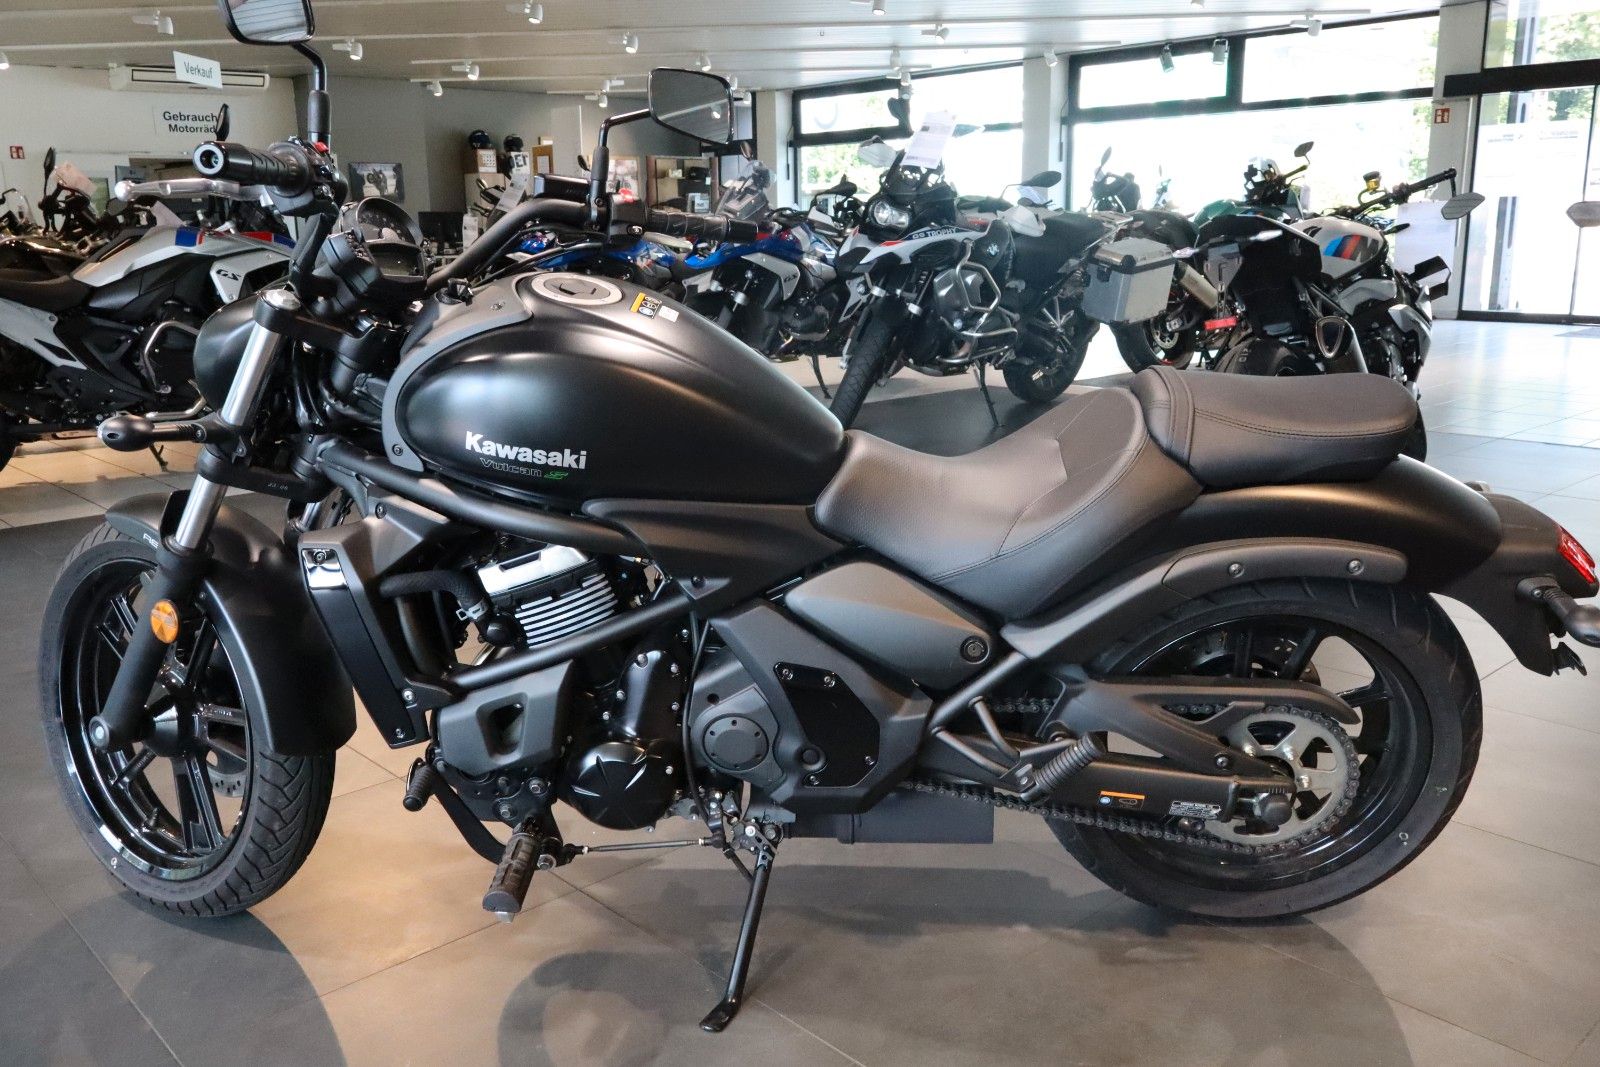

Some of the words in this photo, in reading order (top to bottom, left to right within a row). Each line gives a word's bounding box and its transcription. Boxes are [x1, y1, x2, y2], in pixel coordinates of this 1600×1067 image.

[184, 61, 213, 79] Verkauf
[163, 111, 218, 122] Gebrauch
[169, 124, 217, 133] Motorräd
[927, 227, 957, 238] TROPHY
[465, 430, 587, 470] Kawasaki
